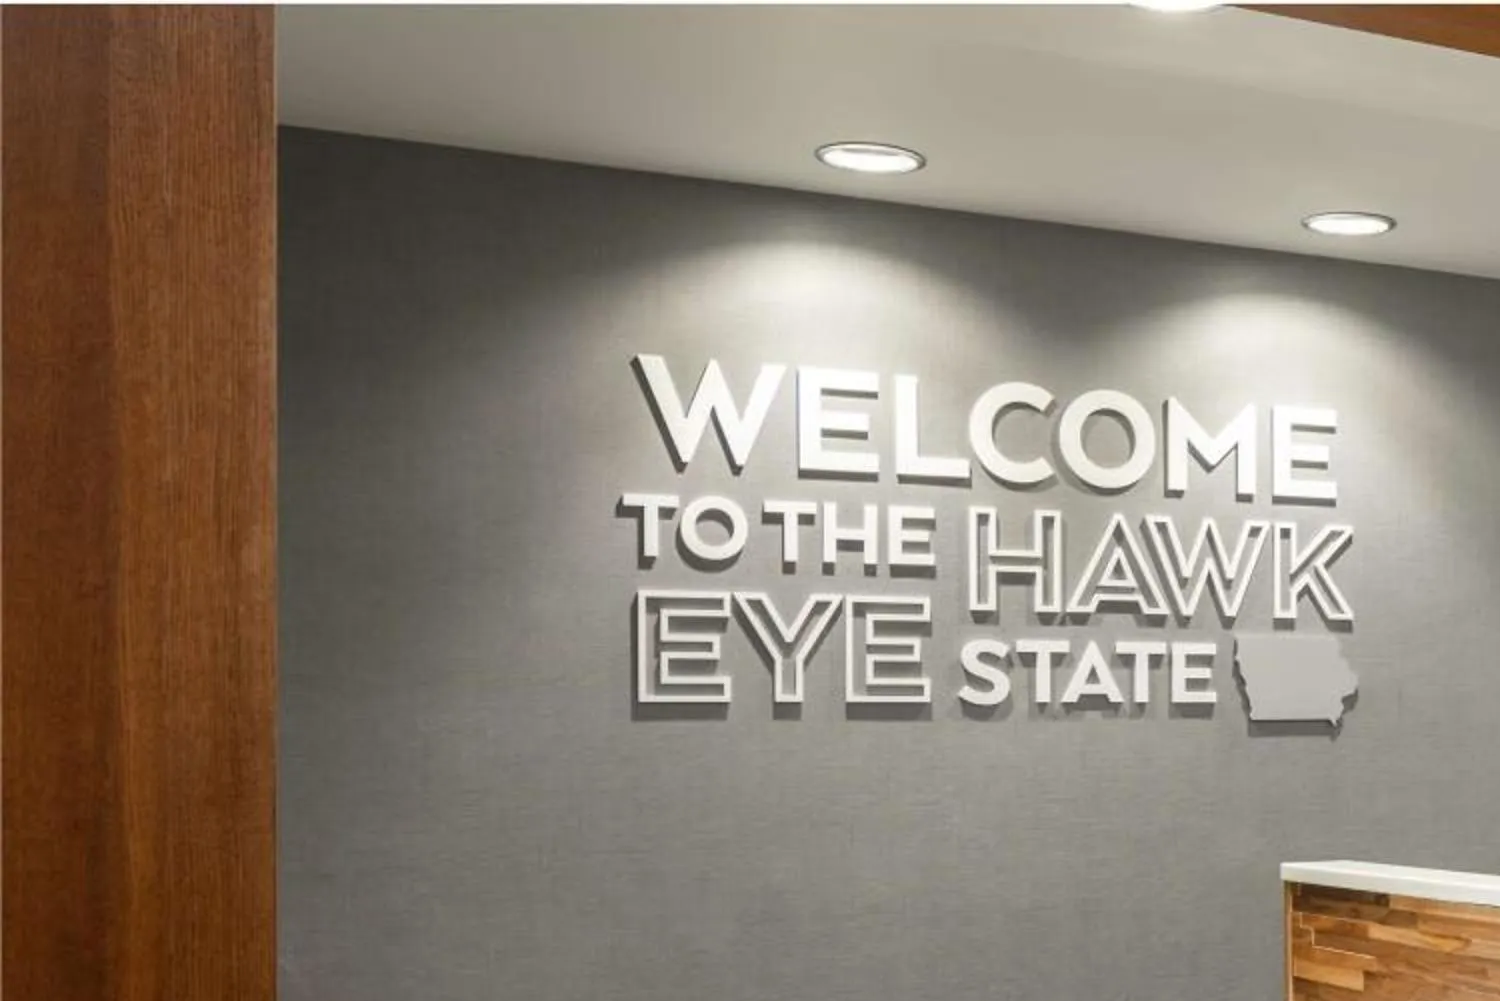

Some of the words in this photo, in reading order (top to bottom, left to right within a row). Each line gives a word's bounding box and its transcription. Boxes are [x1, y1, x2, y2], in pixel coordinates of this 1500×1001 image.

[636, 354, 1338, 501] WELCOME
[623, 494, 748, 561] TO
[763, 501, 936, 566] THE
[968, 506, 1354, 621] HAWK
[637, 589, 931, 702] EYE
[959, 639, 1217, 706] STATE
